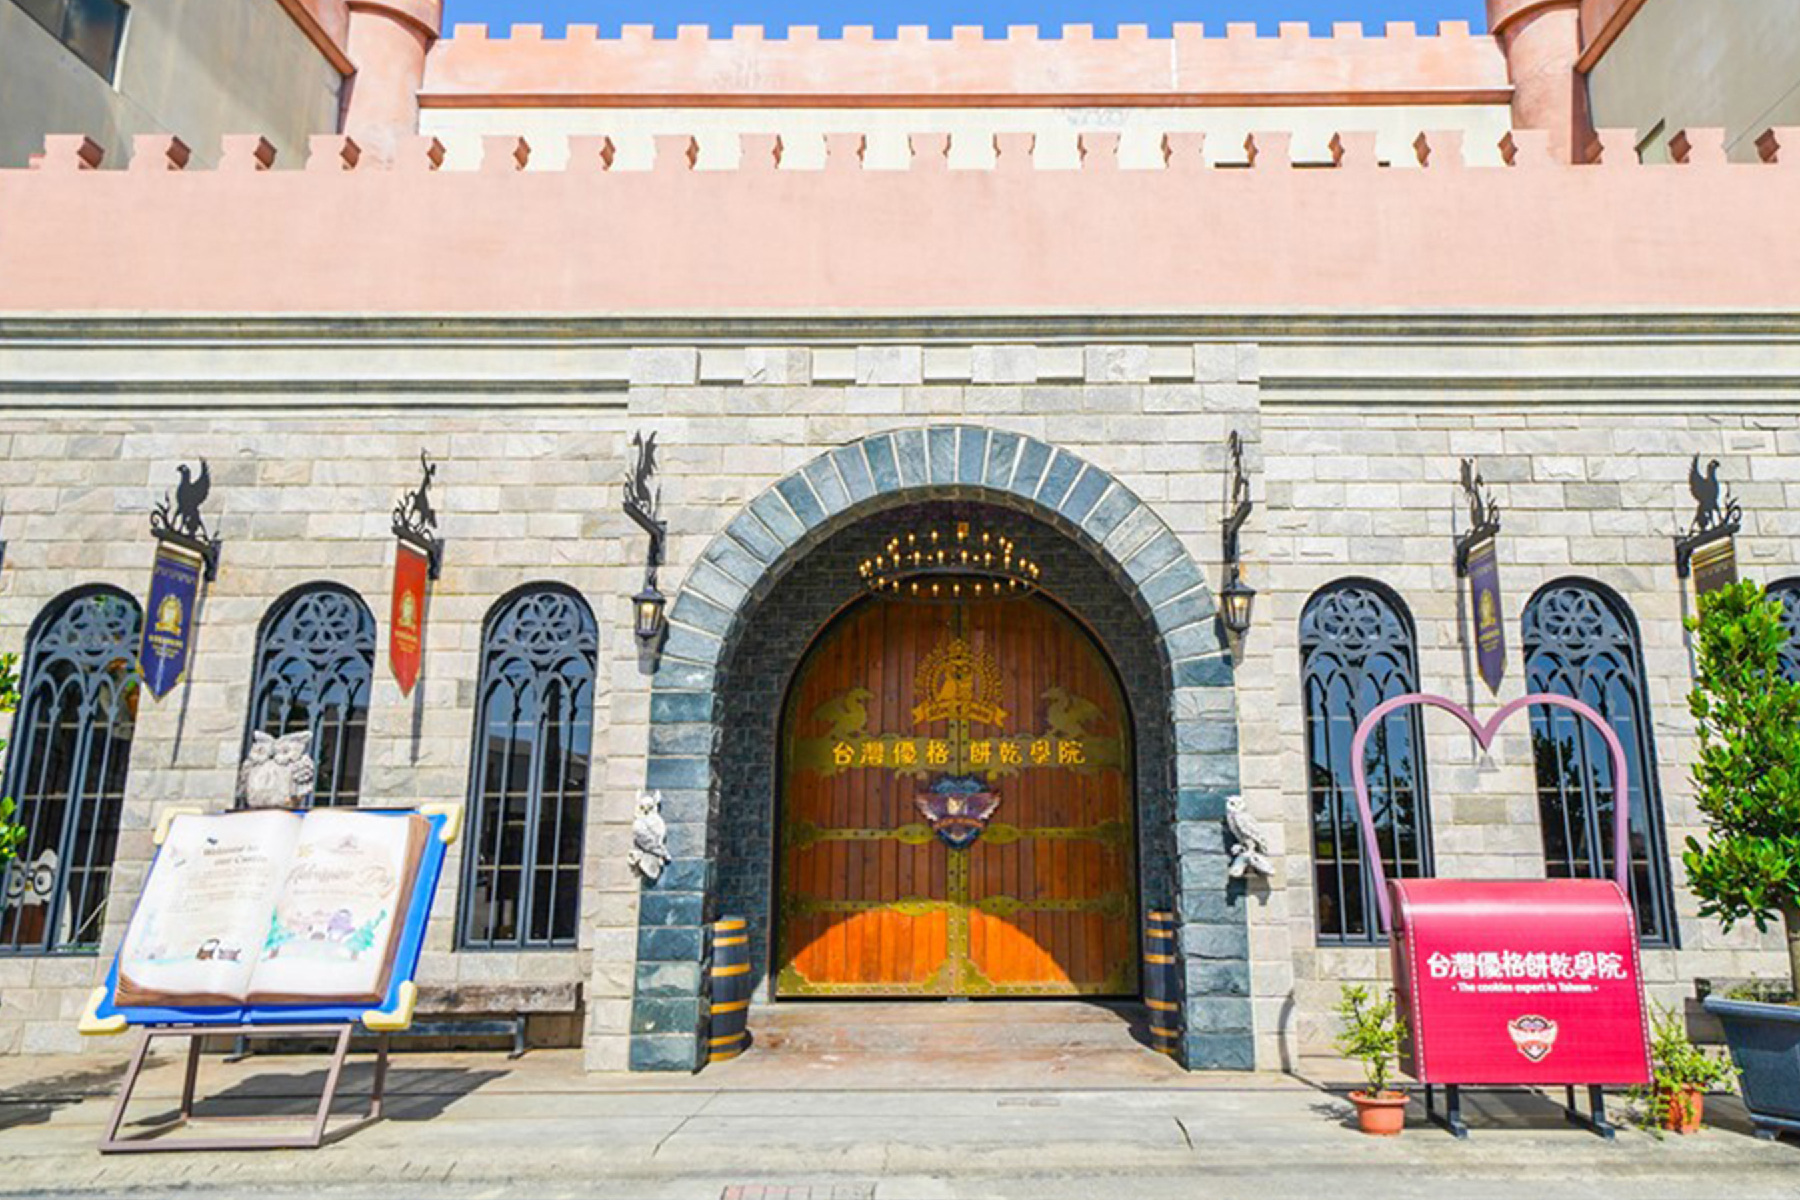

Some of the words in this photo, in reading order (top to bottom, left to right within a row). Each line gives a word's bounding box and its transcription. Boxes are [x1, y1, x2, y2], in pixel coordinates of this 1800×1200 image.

[832, 740, 1086, 765] 台灣優格餅乾學院
[1427, 949, 1628, 979] 台灣優格餅乾學院
[1457, 981, 1475, 992] The
[1478, 981, 1513, 992] cookies
[1514, 982, 1545, 994] expert
